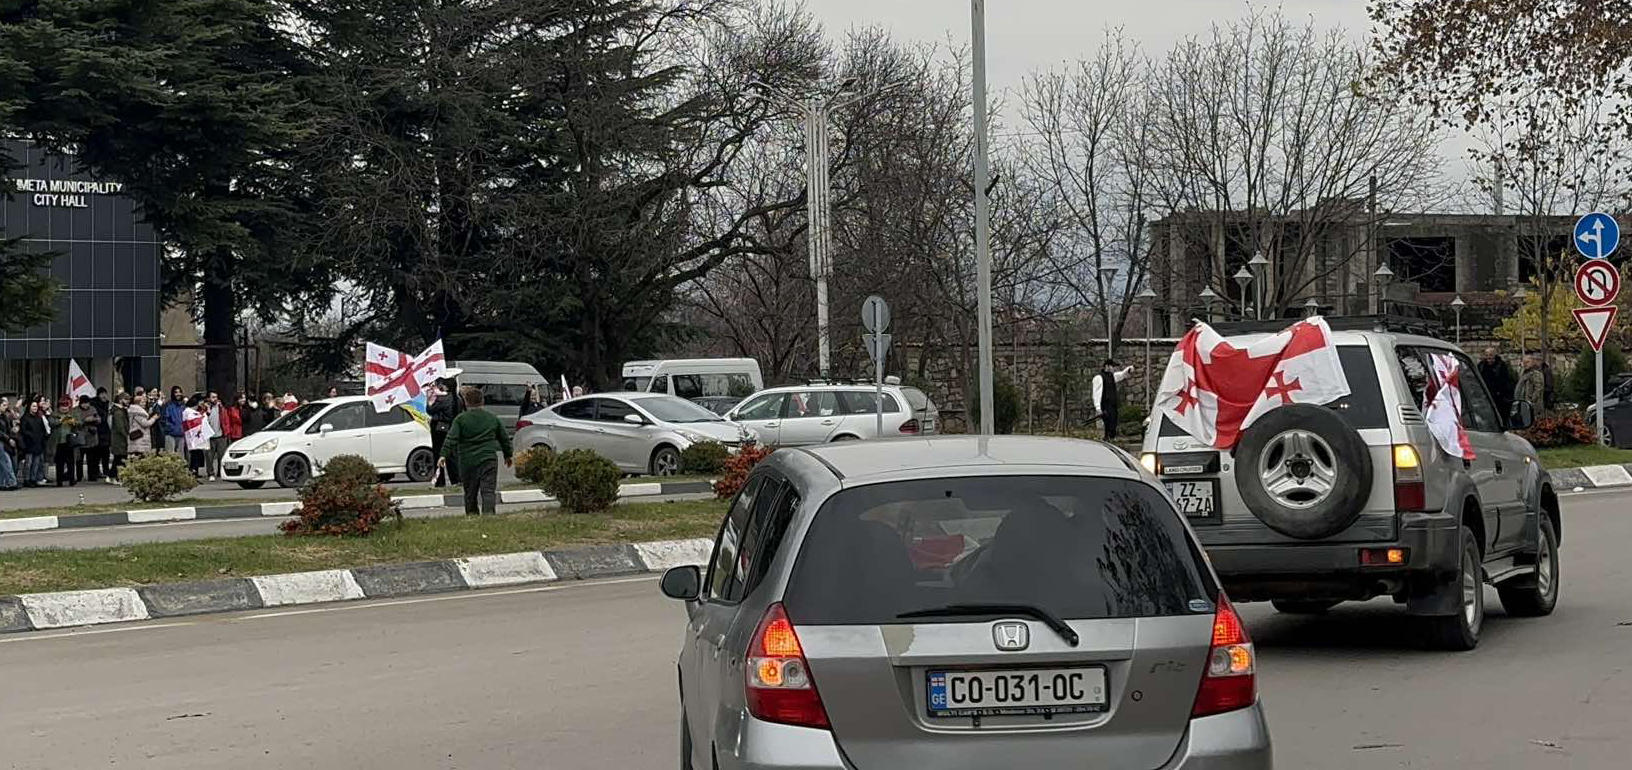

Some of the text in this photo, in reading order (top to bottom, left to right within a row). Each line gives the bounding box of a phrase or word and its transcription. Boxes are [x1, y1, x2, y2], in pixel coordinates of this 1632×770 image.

[49, 180, 122, 194] MUNICIPALITY
[33, 193, 88, 208] CITY HALL
[931, 672, 1085, 705] GE CO-031-OC
